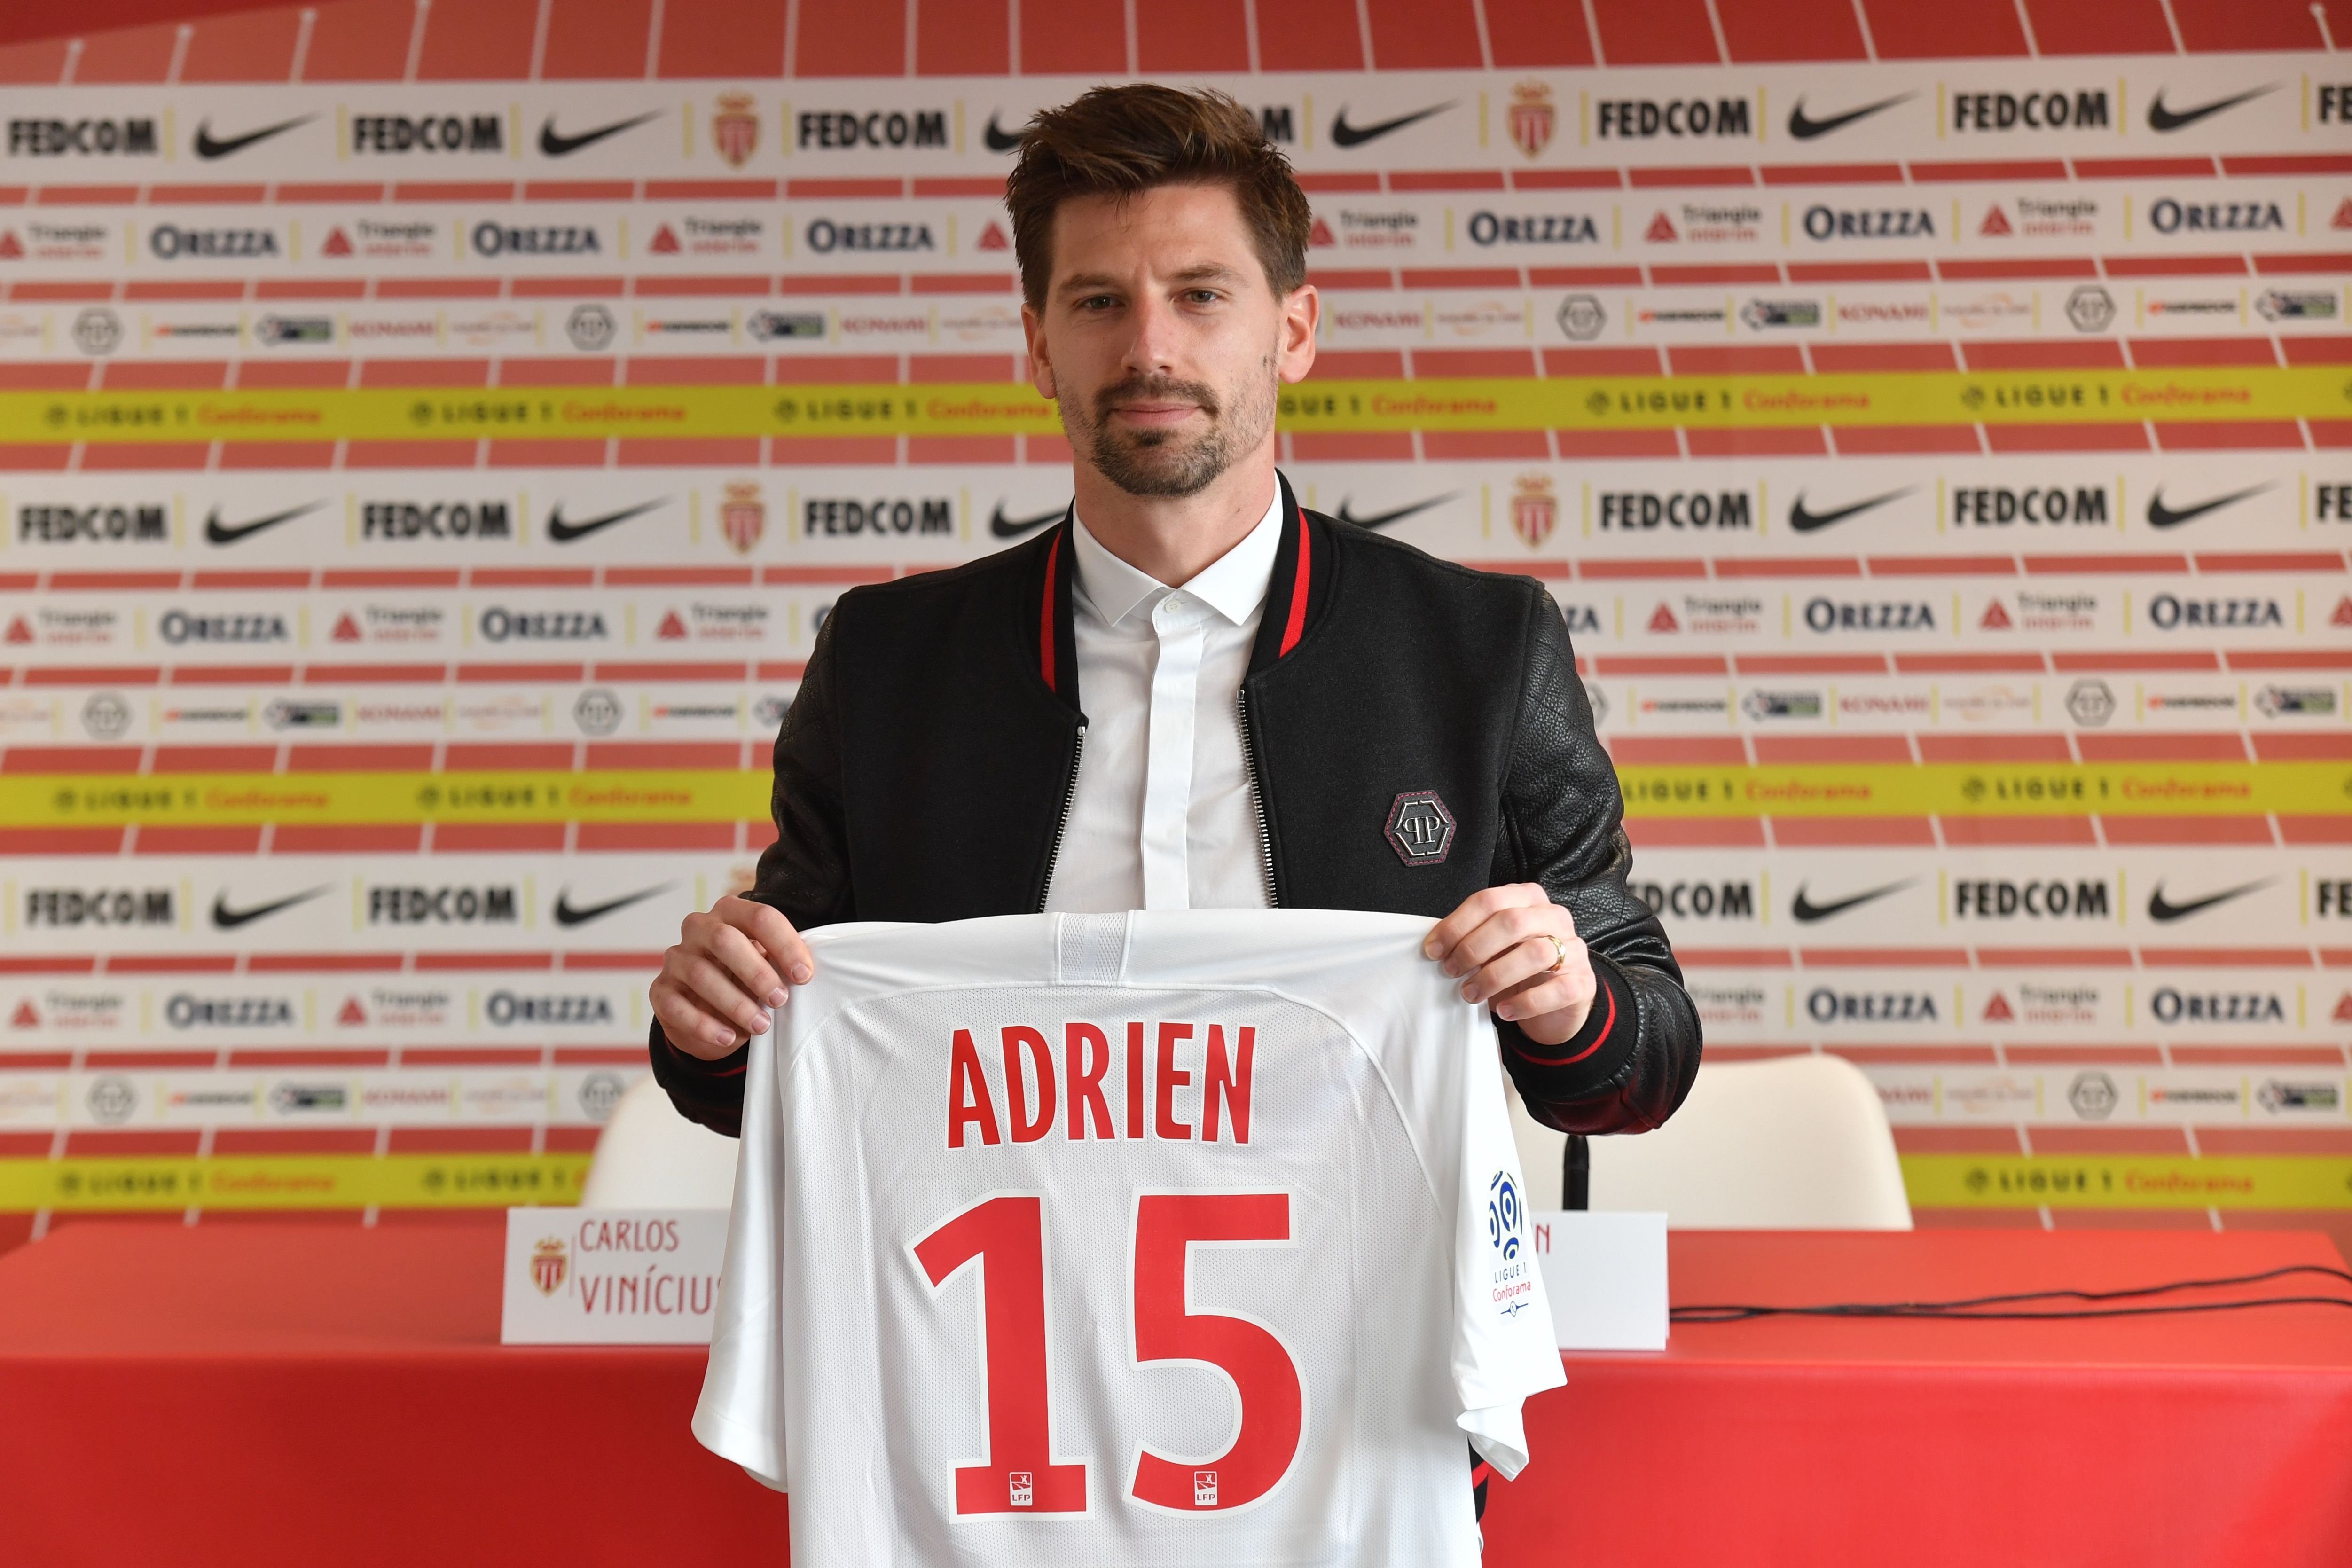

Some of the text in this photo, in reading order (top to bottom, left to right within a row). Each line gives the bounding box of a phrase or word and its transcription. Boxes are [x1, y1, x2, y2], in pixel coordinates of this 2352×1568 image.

[1598, 99, 1750, 138] FEDCOM
[1954, 91, 2109, 131] FEDCOM
[8, 118, 157, 156] FEDCOM
[353, 115, 503, 153] FEDCOM
[798, 111, 947, 149] FEDCOM
[1278, 396, 1335, 416] GUE
[19, 506, 167, 542] FEDCOM
[362, 502, 510, 539] FEDCOM
[805, 499, 952, 536] FEDCOM
[1600, 492, 1751, 530] FEDCOM
[1954, 487, 2108, 525] FEDCOM
[27, 890, 174, 925] FEDCOM
[369, 887, 517, 923] FEDCOM
[1956, 881, 2109, 917] FEDCOM
[948, 1022, 1255, 1149] ADRIEN
[580, 1220, 679, 1251] CARLOS
[580, 1264, 721, 1315] VINÍCIU
[1493, 1281, 1531, 1302] Conforama
[1495, 1264, 1520, 1283] LIGUE
[914, 1193, 1302, 1515] 15
